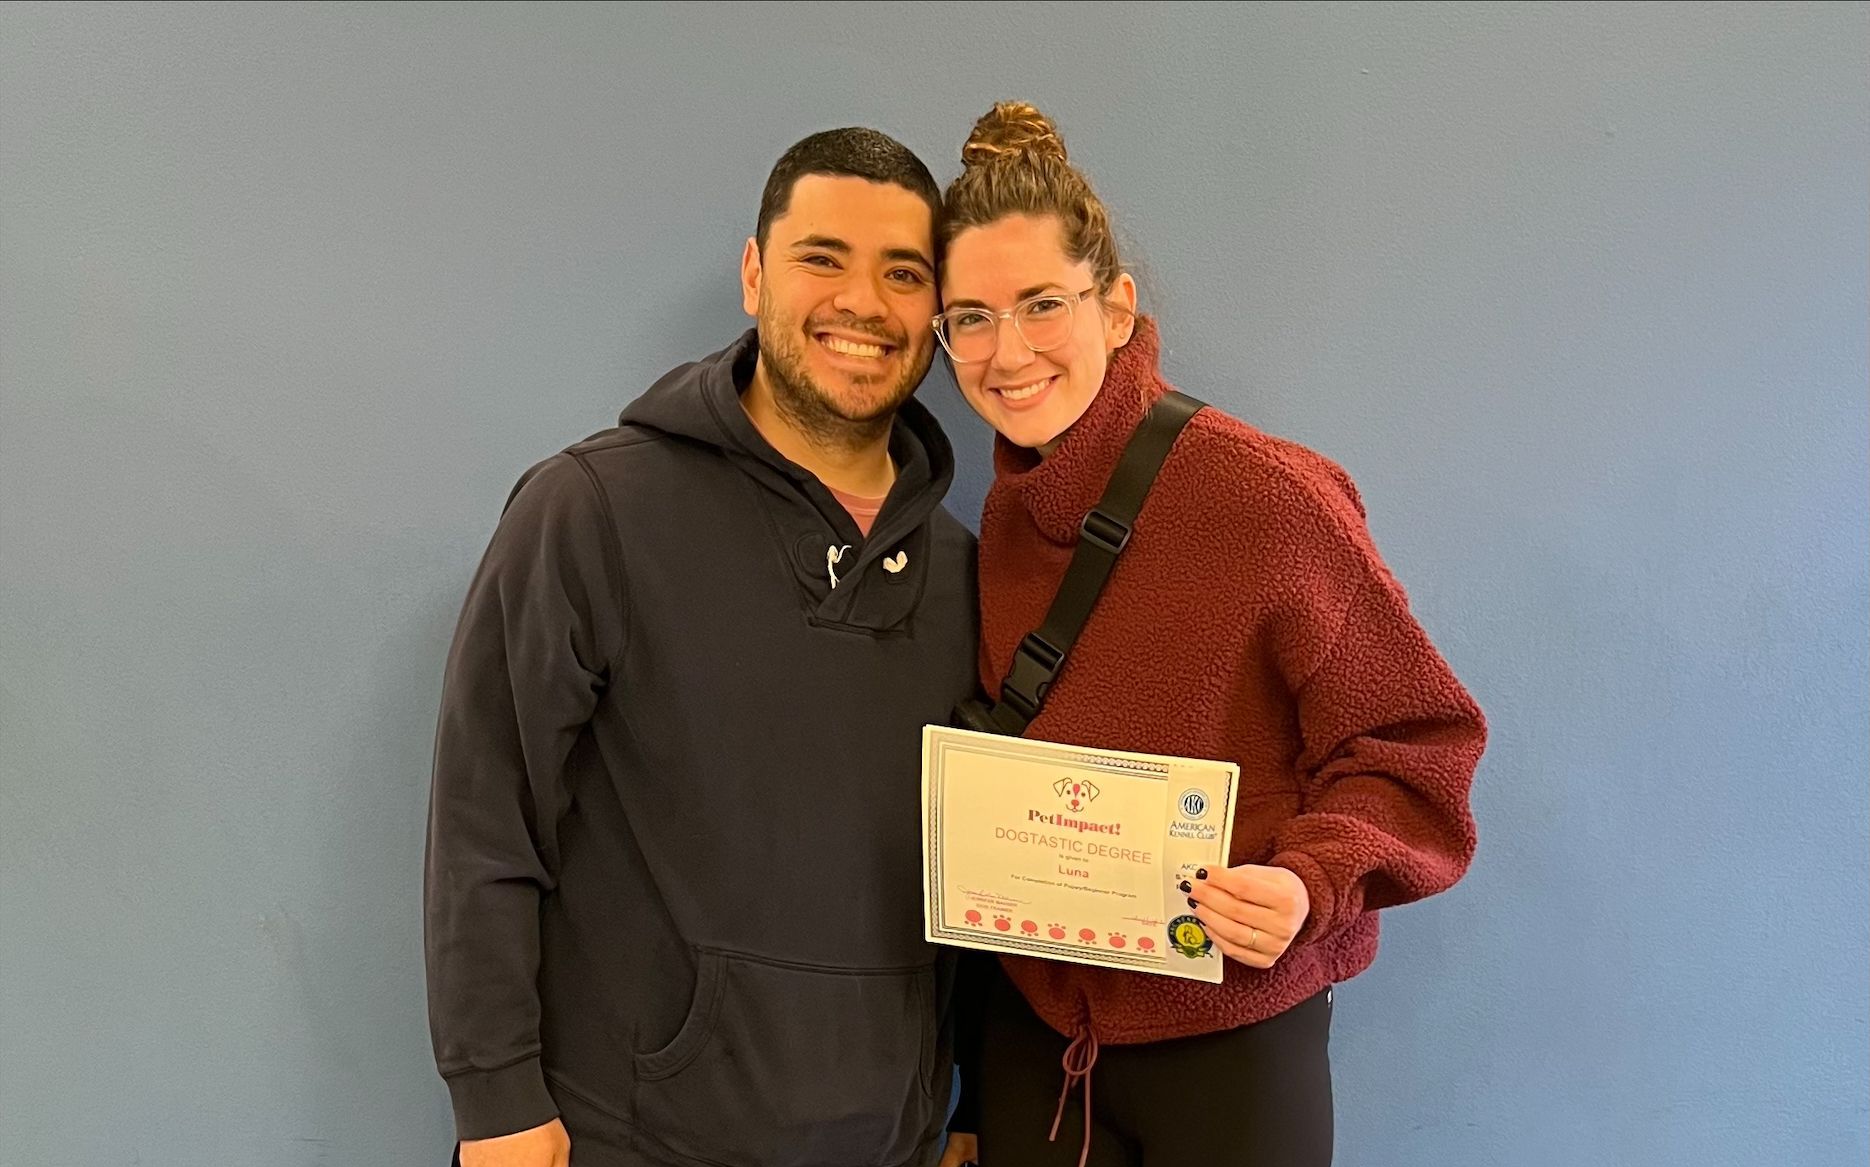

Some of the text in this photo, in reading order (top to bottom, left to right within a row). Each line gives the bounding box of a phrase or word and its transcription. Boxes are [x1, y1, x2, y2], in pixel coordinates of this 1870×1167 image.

[1028, 809, 1121, 836] PetImpact!
[1170, 820, 1216, 832] AMERICAN
[1169, 830, 1195, 839] KENNEL
[995, 827, 1152, 864] DOGTASTIC DEGREE
[1058, 864, 1089, 878] Luna
